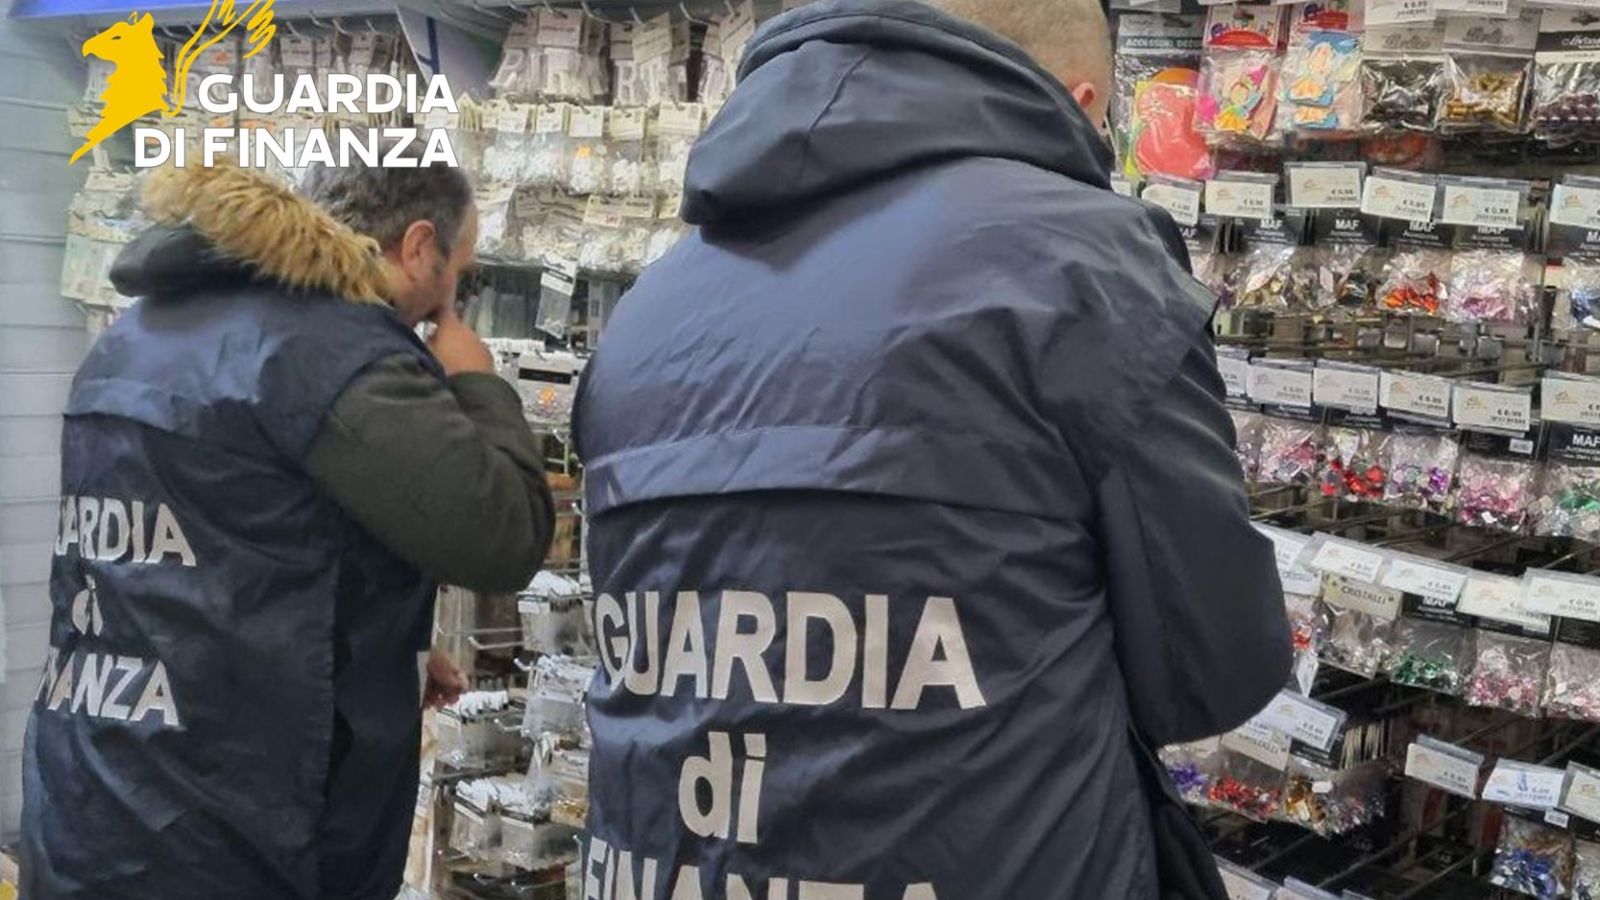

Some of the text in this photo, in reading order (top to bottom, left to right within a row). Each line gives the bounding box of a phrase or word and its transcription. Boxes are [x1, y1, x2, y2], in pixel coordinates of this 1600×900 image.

[1177, 39, 1200, 48] DECO
[1335, 218, 1360, 230] MAF
[1409, 220, 1436, 232] MAF
[1181, 228, 1197, 237] AF
[1573, 434, 1600, 447] MAF
[55, 495, 197, 566] ARDIA
[596, 590, 987, 710] GUARDIA
[678, 731, 768, 844] di
